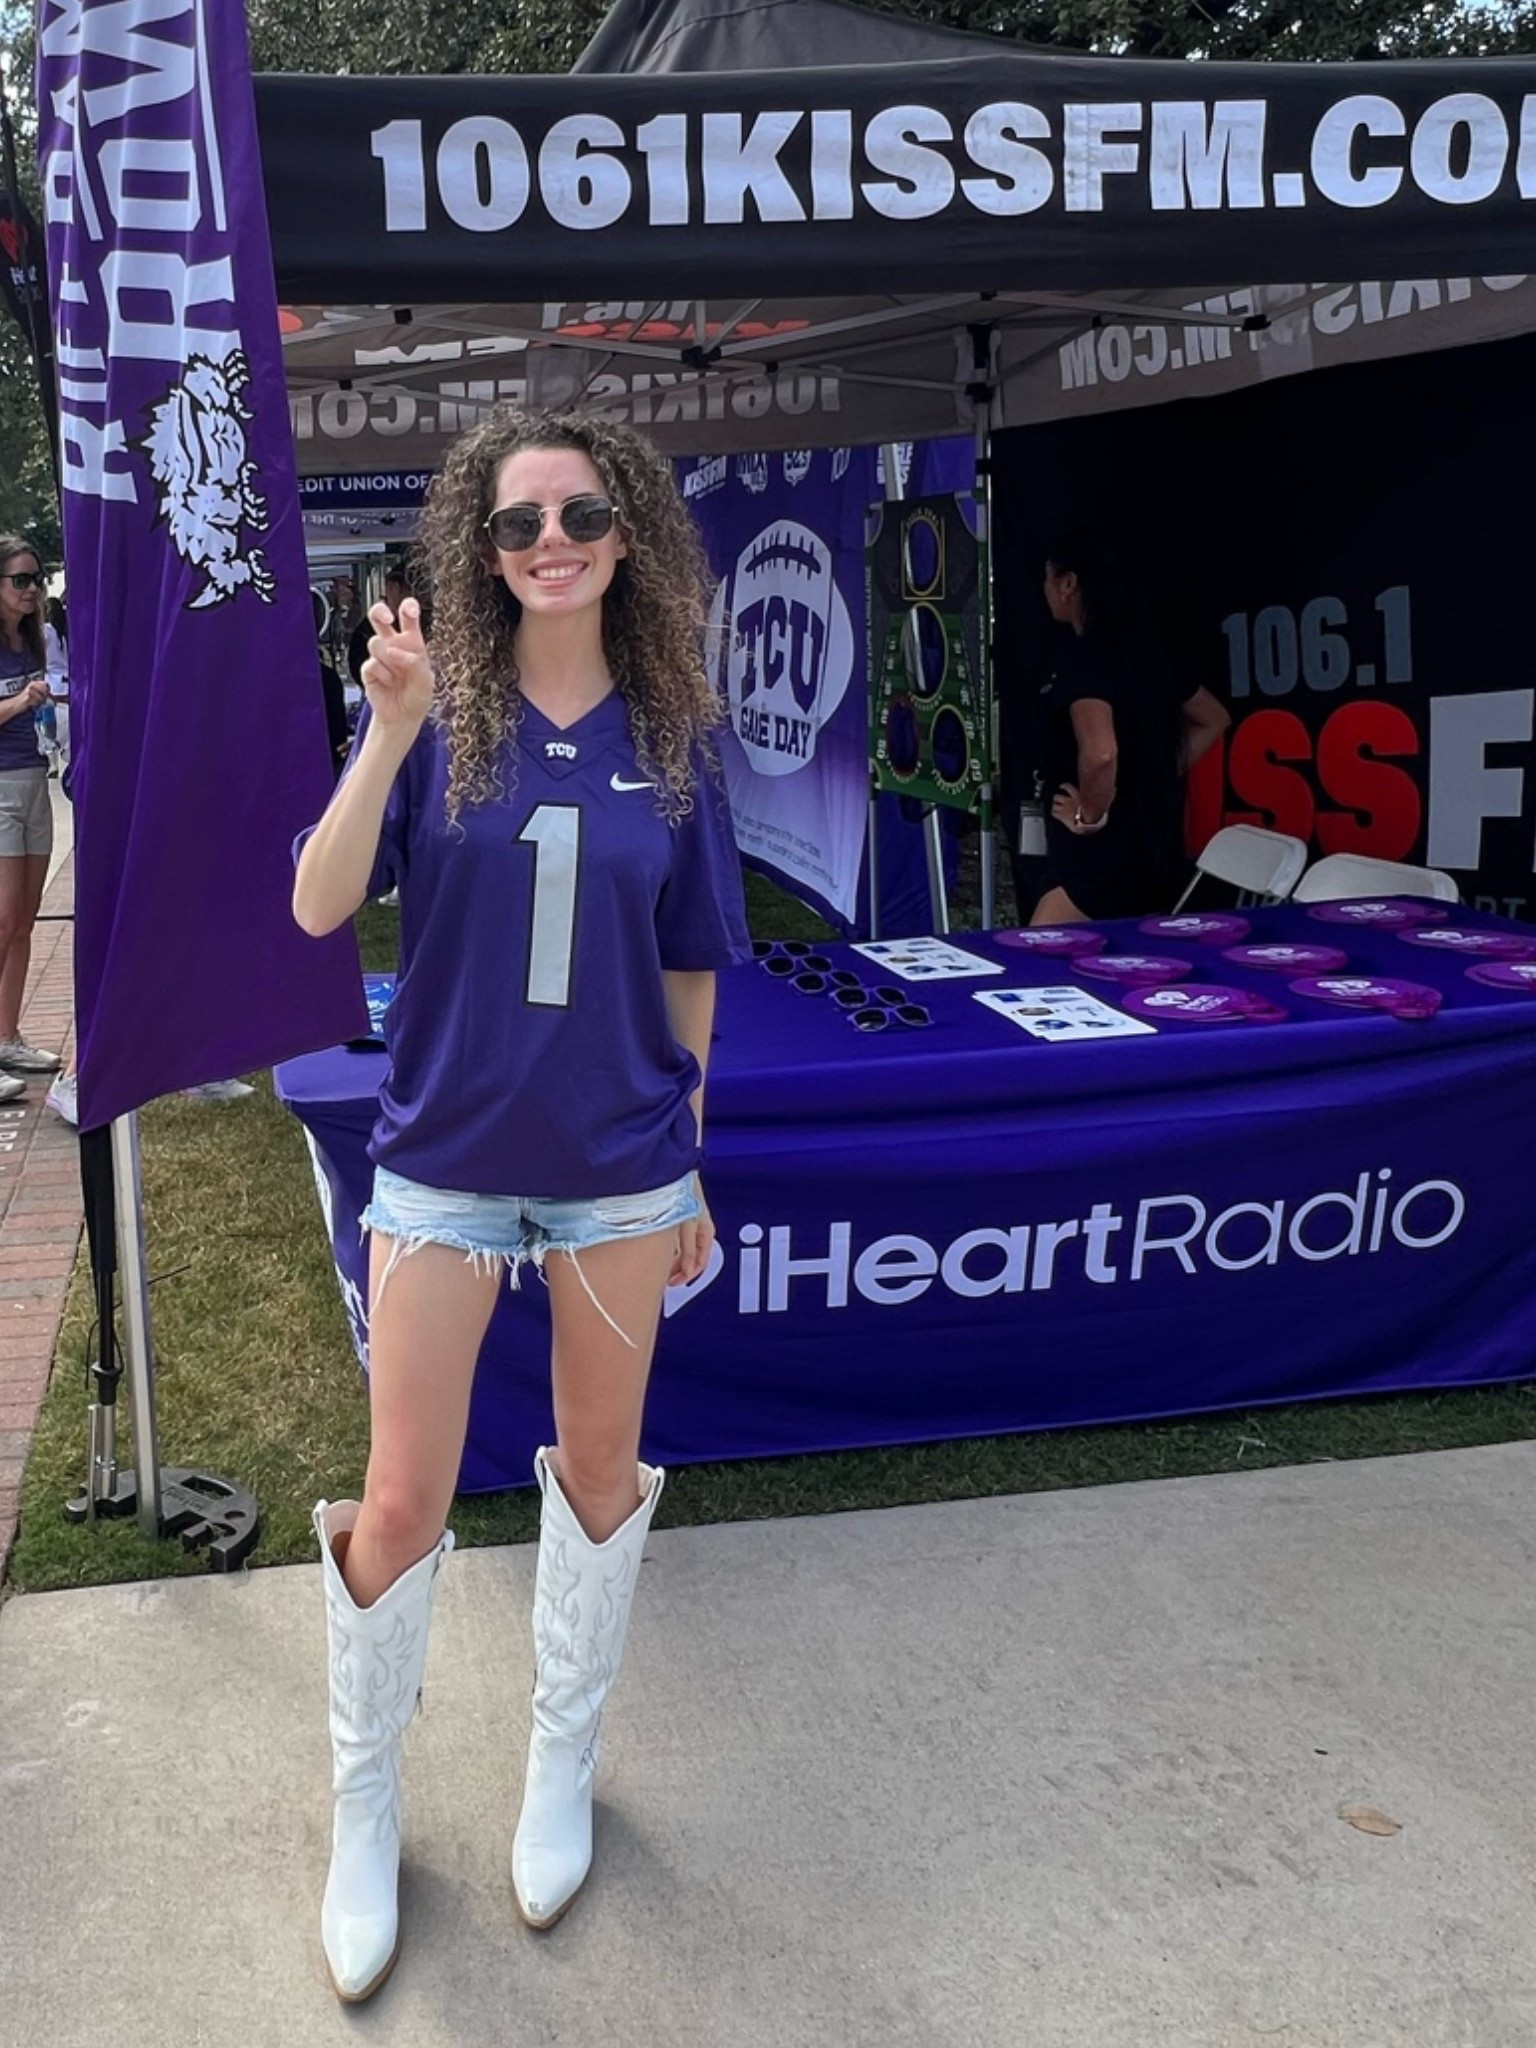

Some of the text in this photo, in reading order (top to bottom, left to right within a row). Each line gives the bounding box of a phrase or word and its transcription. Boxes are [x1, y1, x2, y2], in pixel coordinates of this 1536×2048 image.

[370, 93, 1536, 233] 1061KISSFM.CO
[340, 475, 400, 491] UNION
[736, 595, 825, 716] TCU
[1221, 585, 1413, 698] 106.1
[545, 741, 578, 760] TCU
[774, 716, 812, 759] DAY
[515, 803, 581, 1008] 1
[738, 1167, 1466, 1315] iHeartRadio
